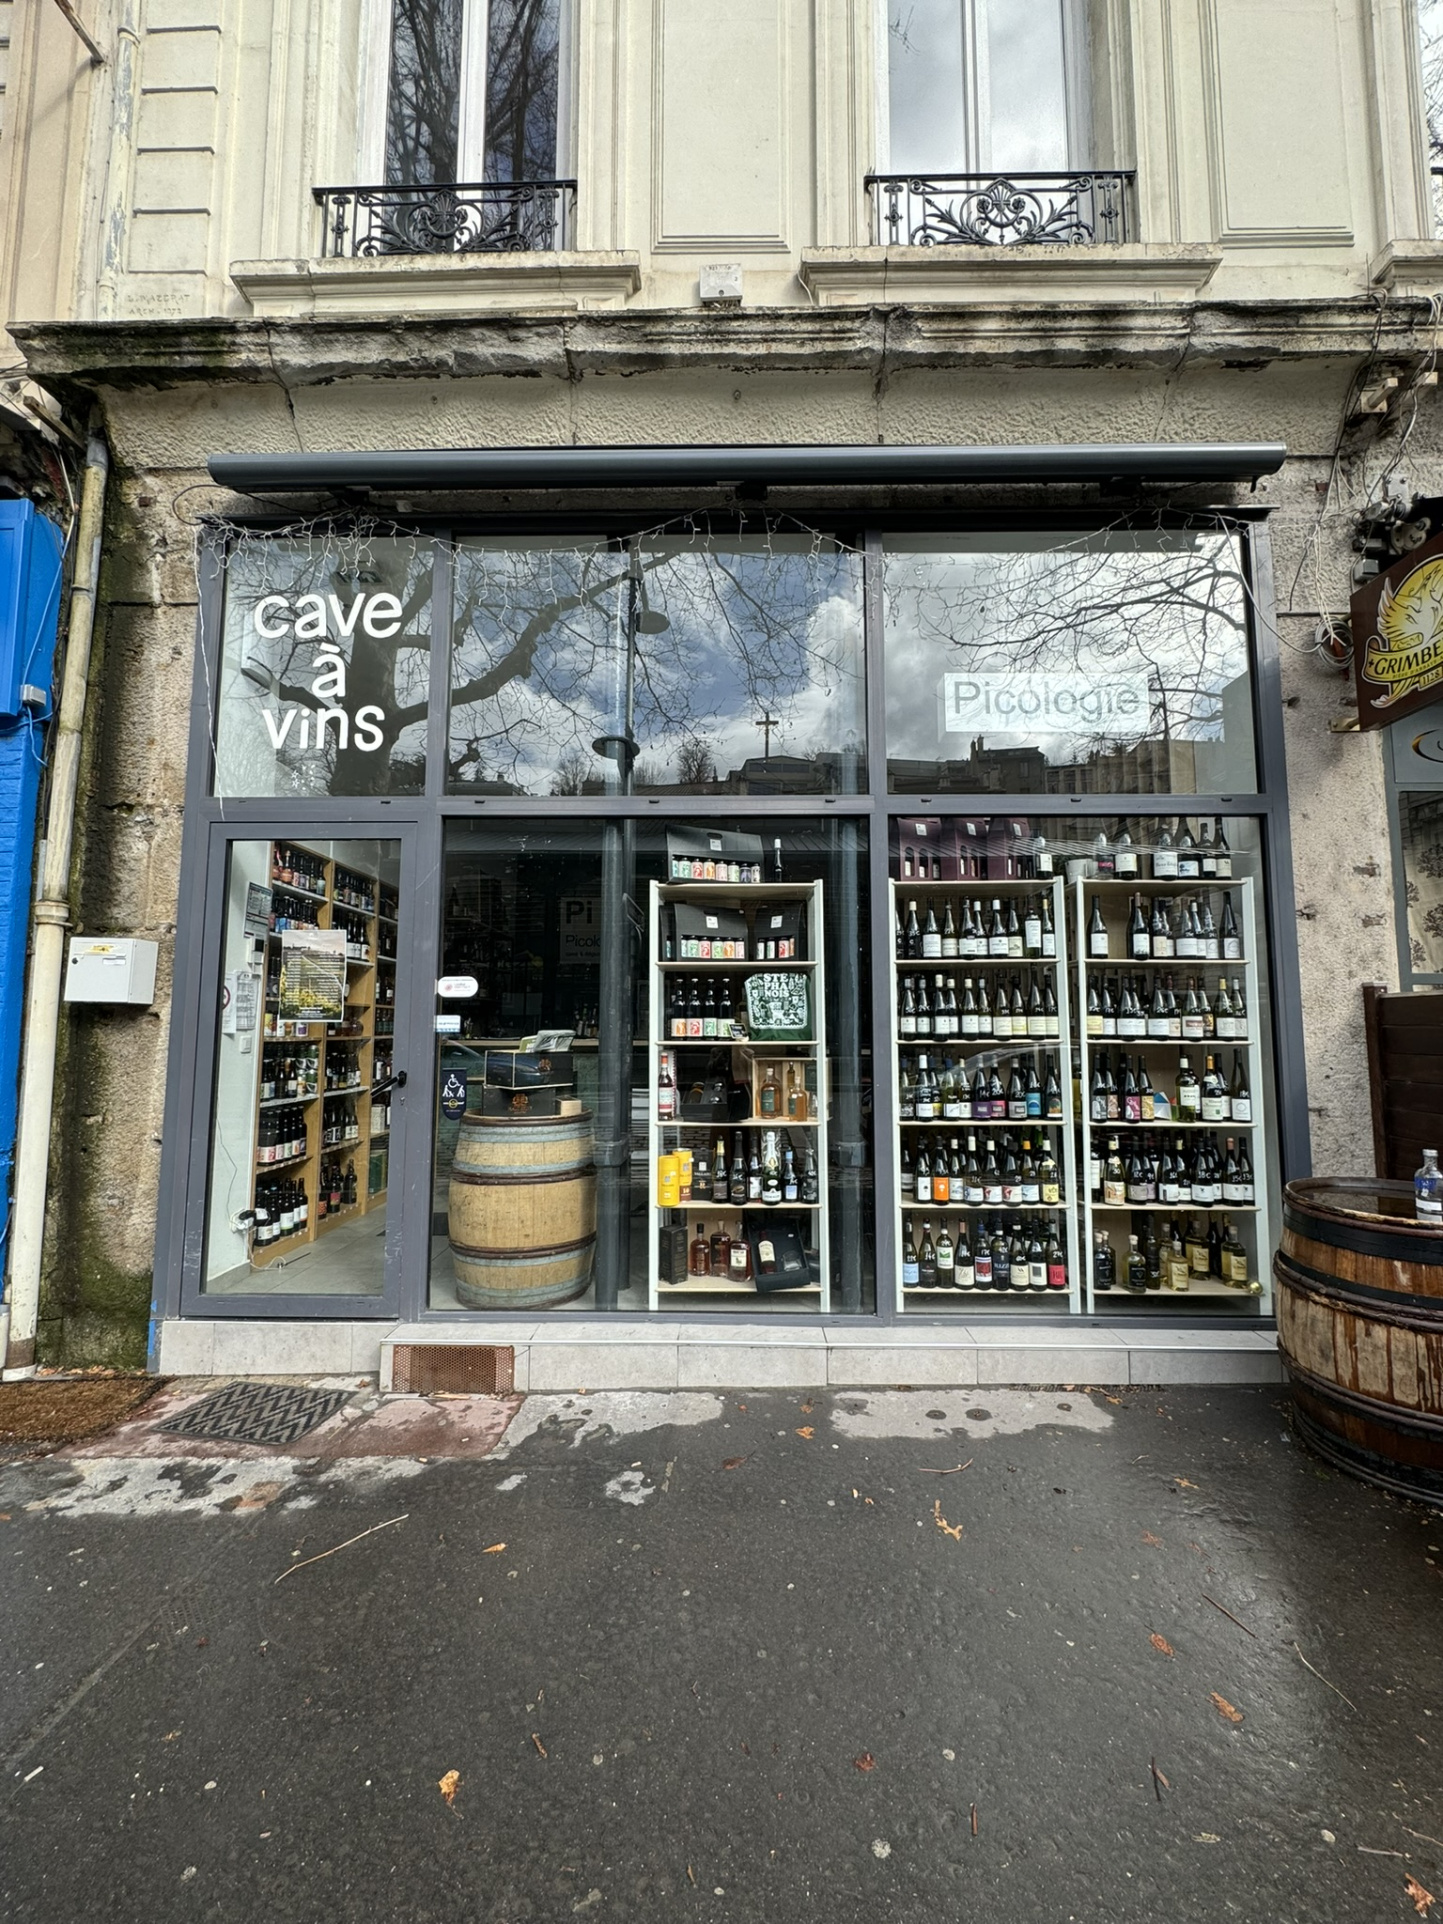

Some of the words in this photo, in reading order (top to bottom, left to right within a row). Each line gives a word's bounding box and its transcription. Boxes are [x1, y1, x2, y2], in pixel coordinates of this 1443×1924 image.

[254, 592, 403, 639] cave
[312, 643, 346, 698] à
[954, 681, 1139, 724] Picologie
[263, 705, 385, 752] vins
[567, 901, 592, 924] Pi
[763, 973, 789, 983] STE
[764, 982, 788, 990] PHA
[764, 990, 790, 998] NOIS
